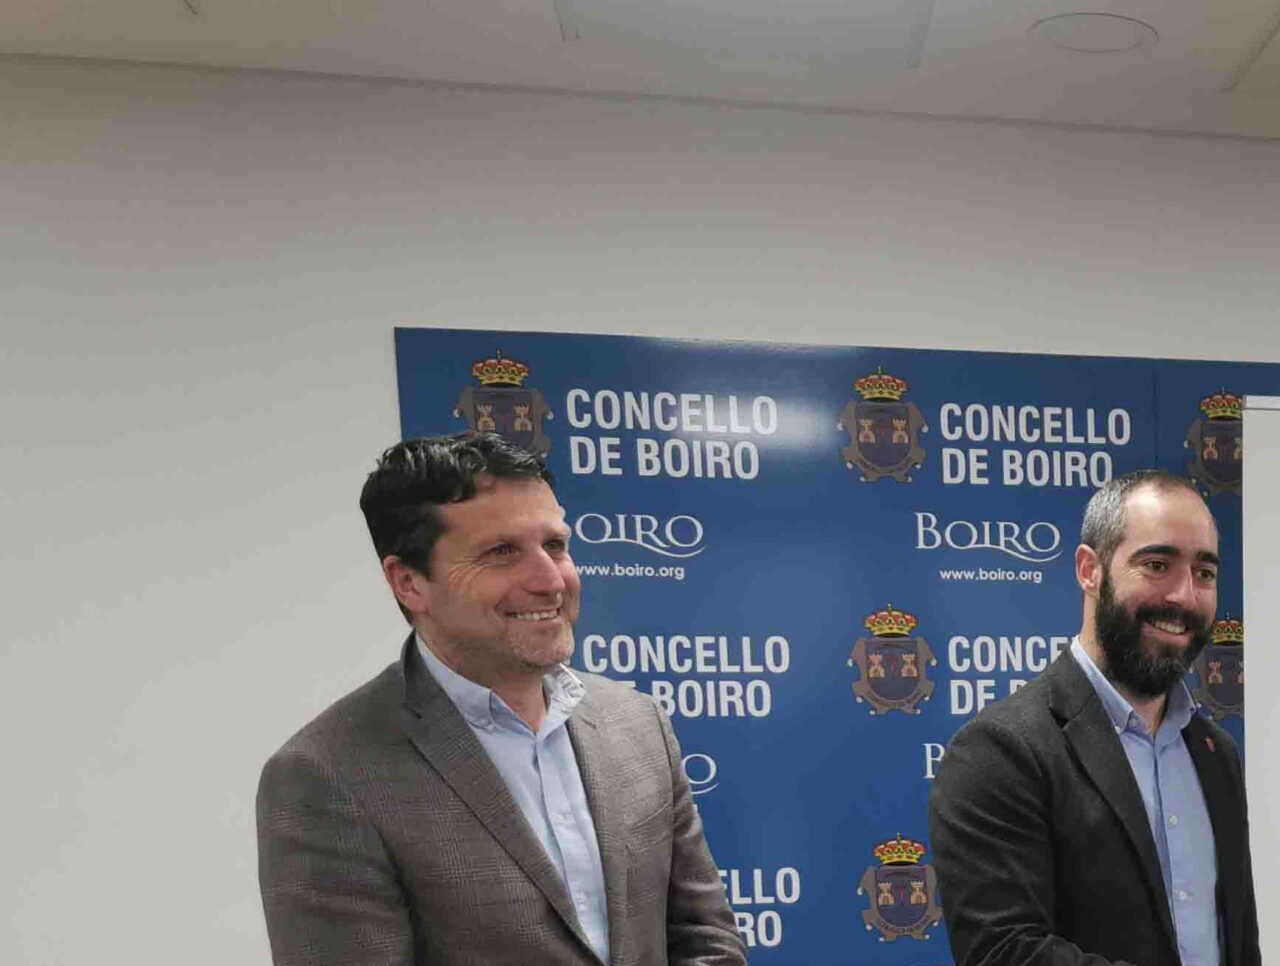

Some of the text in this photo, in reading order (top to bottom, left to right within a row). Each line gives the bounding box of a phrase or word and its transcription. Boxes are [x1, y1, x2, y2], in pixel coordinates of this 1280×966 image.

[566, 388, 778, 435] CONCELLO
[940, 402, 1131, 445] CONCELLO
[570, 436, 760, 480] DE BOIRO
[942, 448, 989, 485] DE
[1003, 449, 1112, 488] BOIRO
[575, 513, 707, 557] OIRO
[940, 567, 1042, 583] www.boiro.org
[583, 634, 790, 673] CONCELLO
[651, 680, 772, 717] BOIRO
